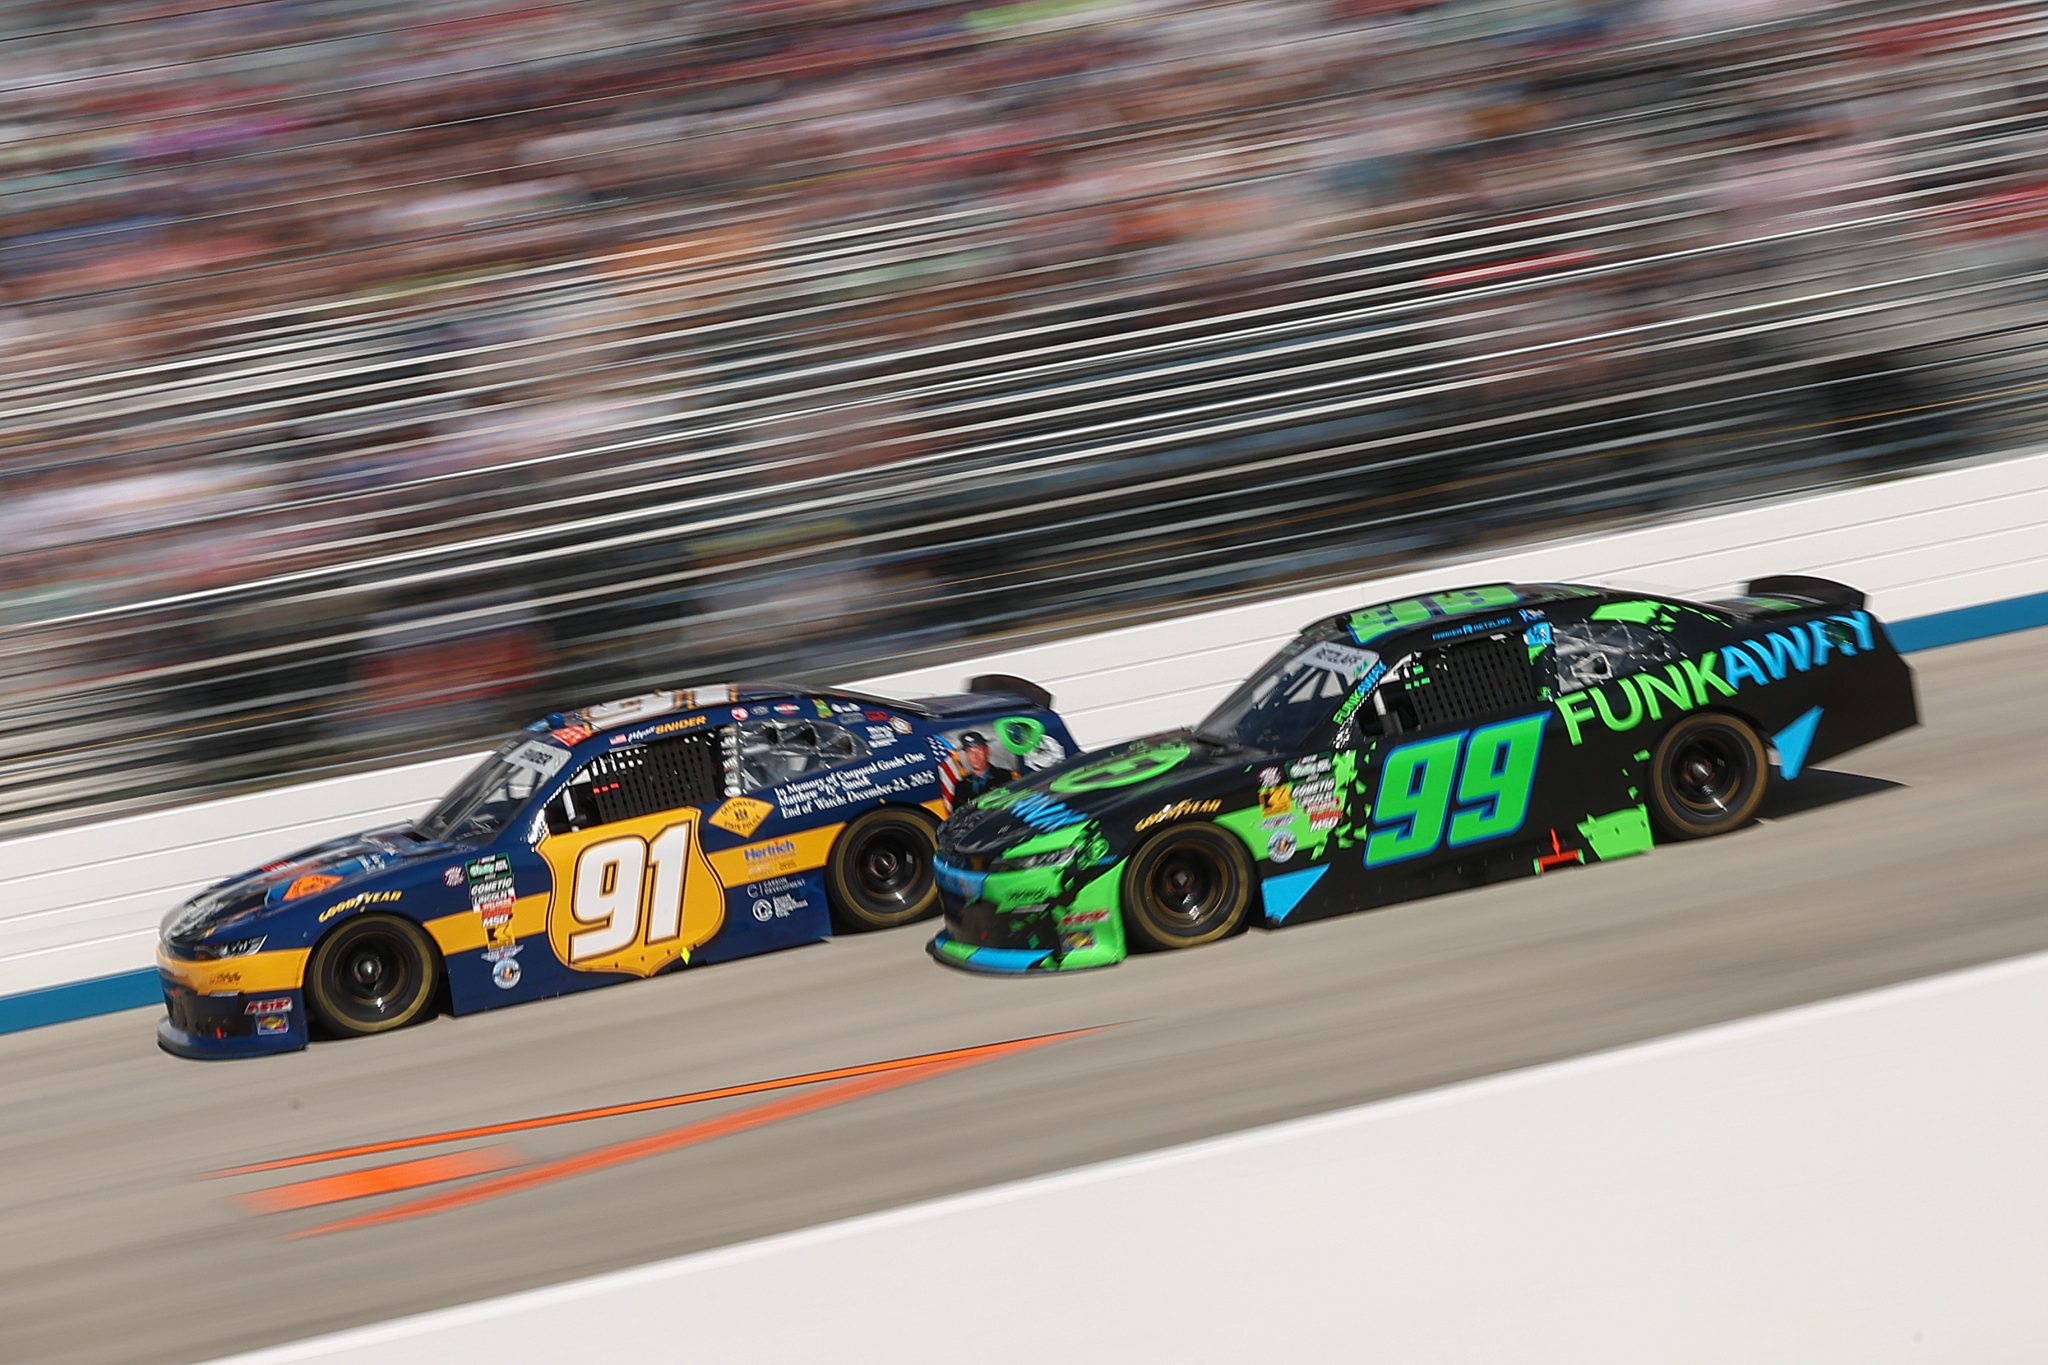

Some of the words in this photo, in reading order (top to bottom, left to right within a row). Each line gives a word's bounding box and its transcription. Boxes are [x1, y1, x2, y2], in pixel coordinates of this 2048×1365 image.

[1555, 610, 1875, 746] FUNKAWAY
[654, 715, 707, 735] SNIDER
[786, 778, 825, 795] Memory
[825, 772, 840, 787] of
[836, 762, 878, 781] Corporal
[877, 756, 907, 771] Grade
[904, 753, 926, 764] One
[1363, 710, 1552, 870] 99
[779, 790, 818, 806] Matthew
[781, 804, 802, 819] End
[801, 800, 813, 814] of
[847, 783, 893, 803] December
[318, 890, 403, 923] GOODYEAR
[567, 820, 692, 967] 91
